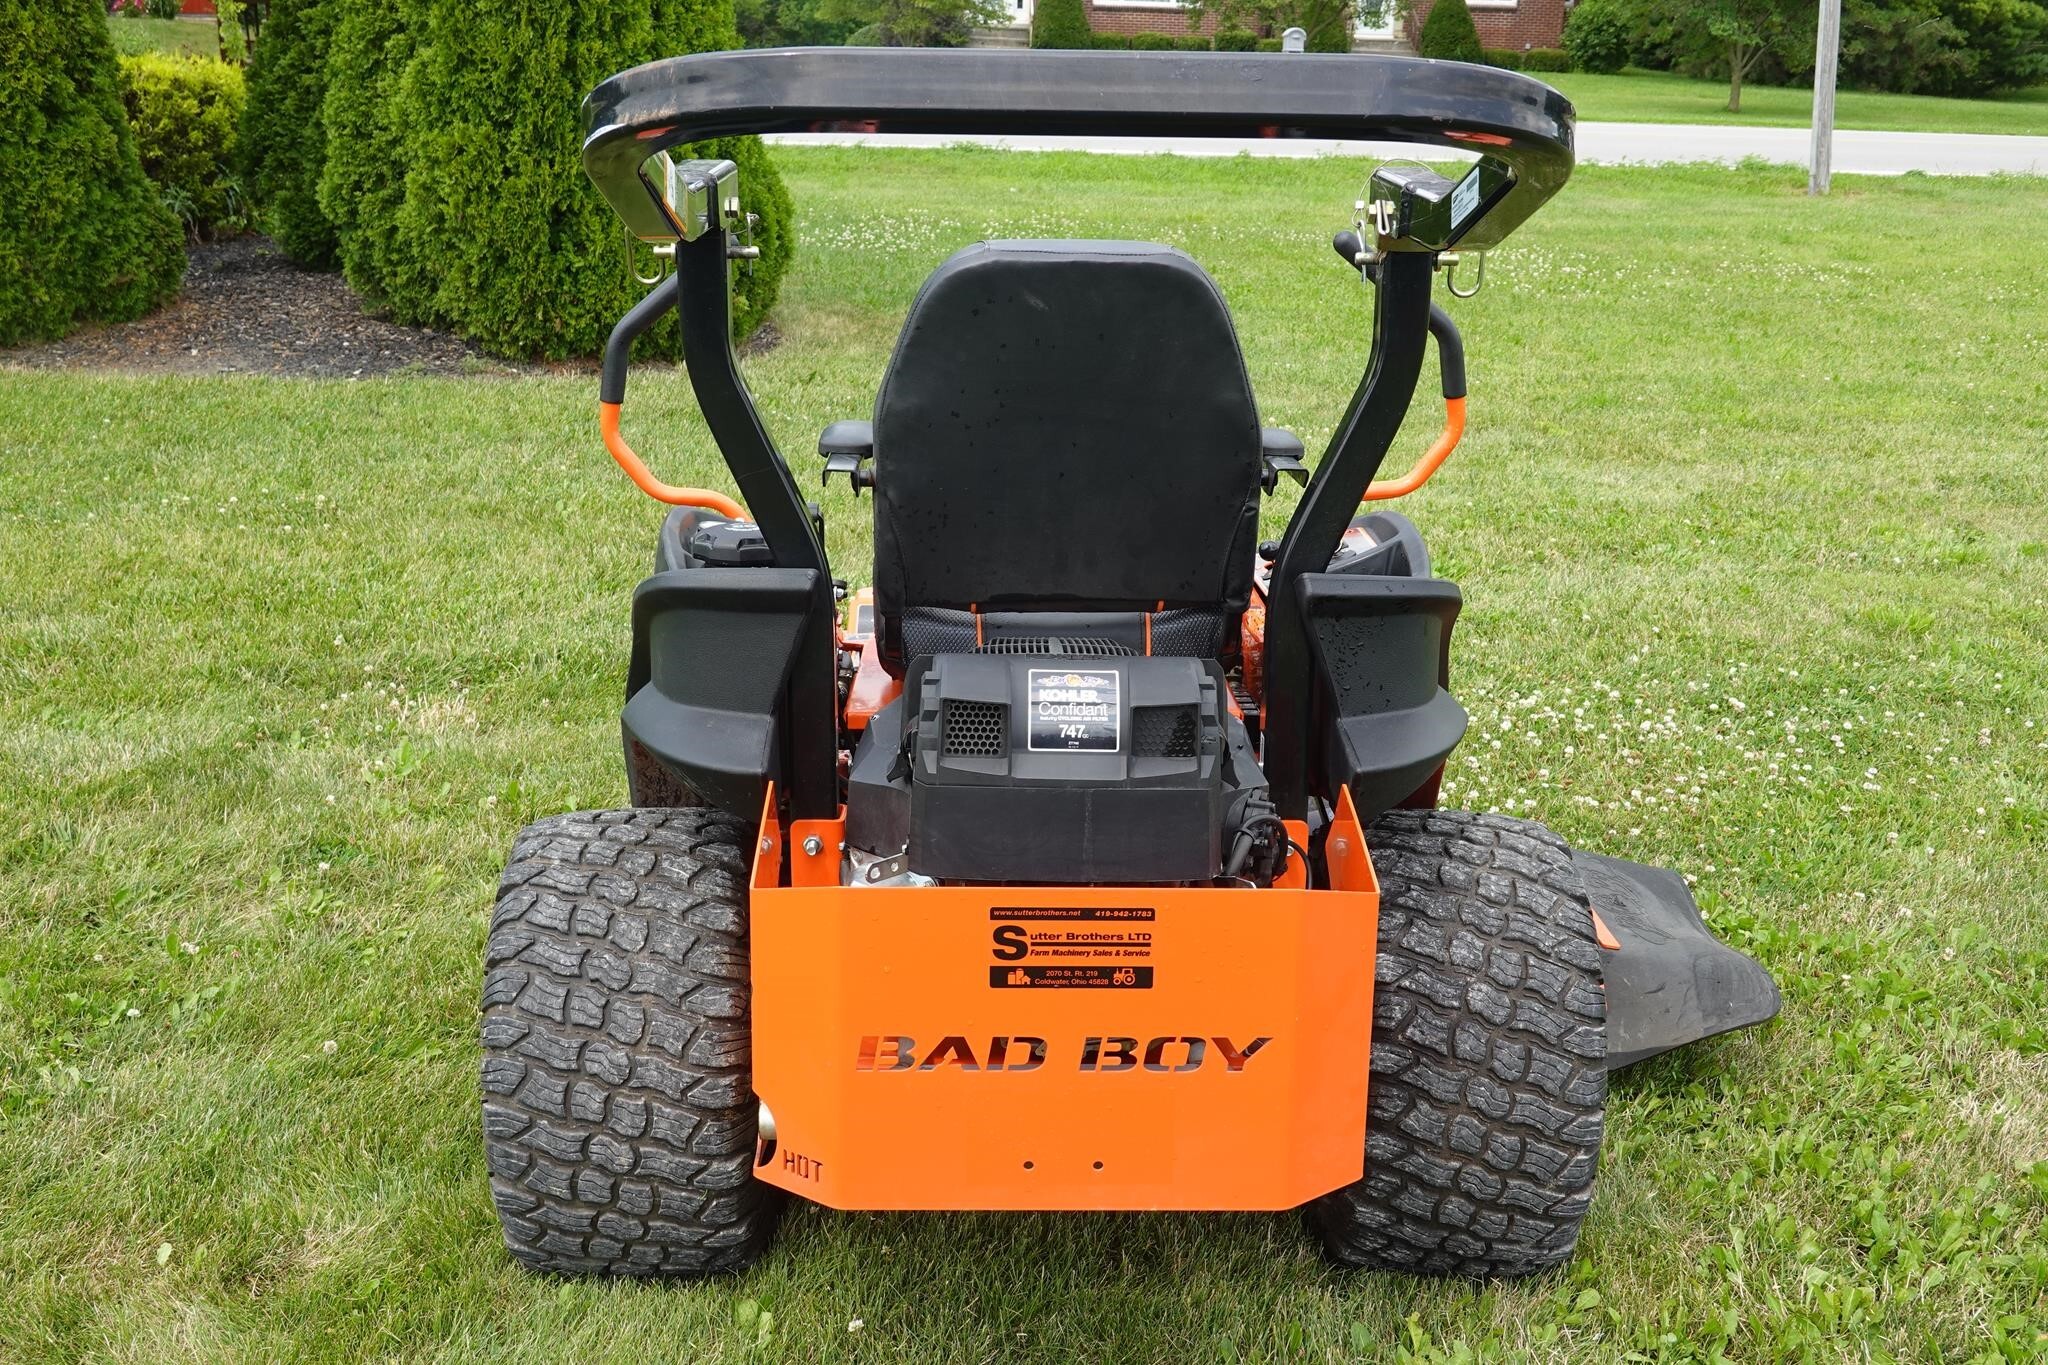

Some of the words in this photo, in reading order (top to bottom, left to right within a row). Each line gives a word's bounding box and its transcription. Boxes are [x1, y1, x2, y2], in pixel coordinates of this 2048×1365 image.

[1039, 689, 1098, 702] KOHLER
[1039, 702, 1108, 716] Confidant
[993, 909, 1081, 917] www.sutterbrothers.net
[1094, 910, 1152, 918] 419-942-1783
[1066, 932, 1124, 941] Brothers
[1127, 933, 1152, 941] LTD
[1030, 949, 1050, 957] Farm
[1051, 948, 1091, 958] Machinery
[1092, 949, 1113, 957] Sales
[1114, 949, 1121, 957] &
[1122, 949, 1151, 957] Service
[855, 1035, 1049, 1072] BAD
[1078, 1036, 1274, 1073] BOY
[783, 1148, 824, 1183] HOT
